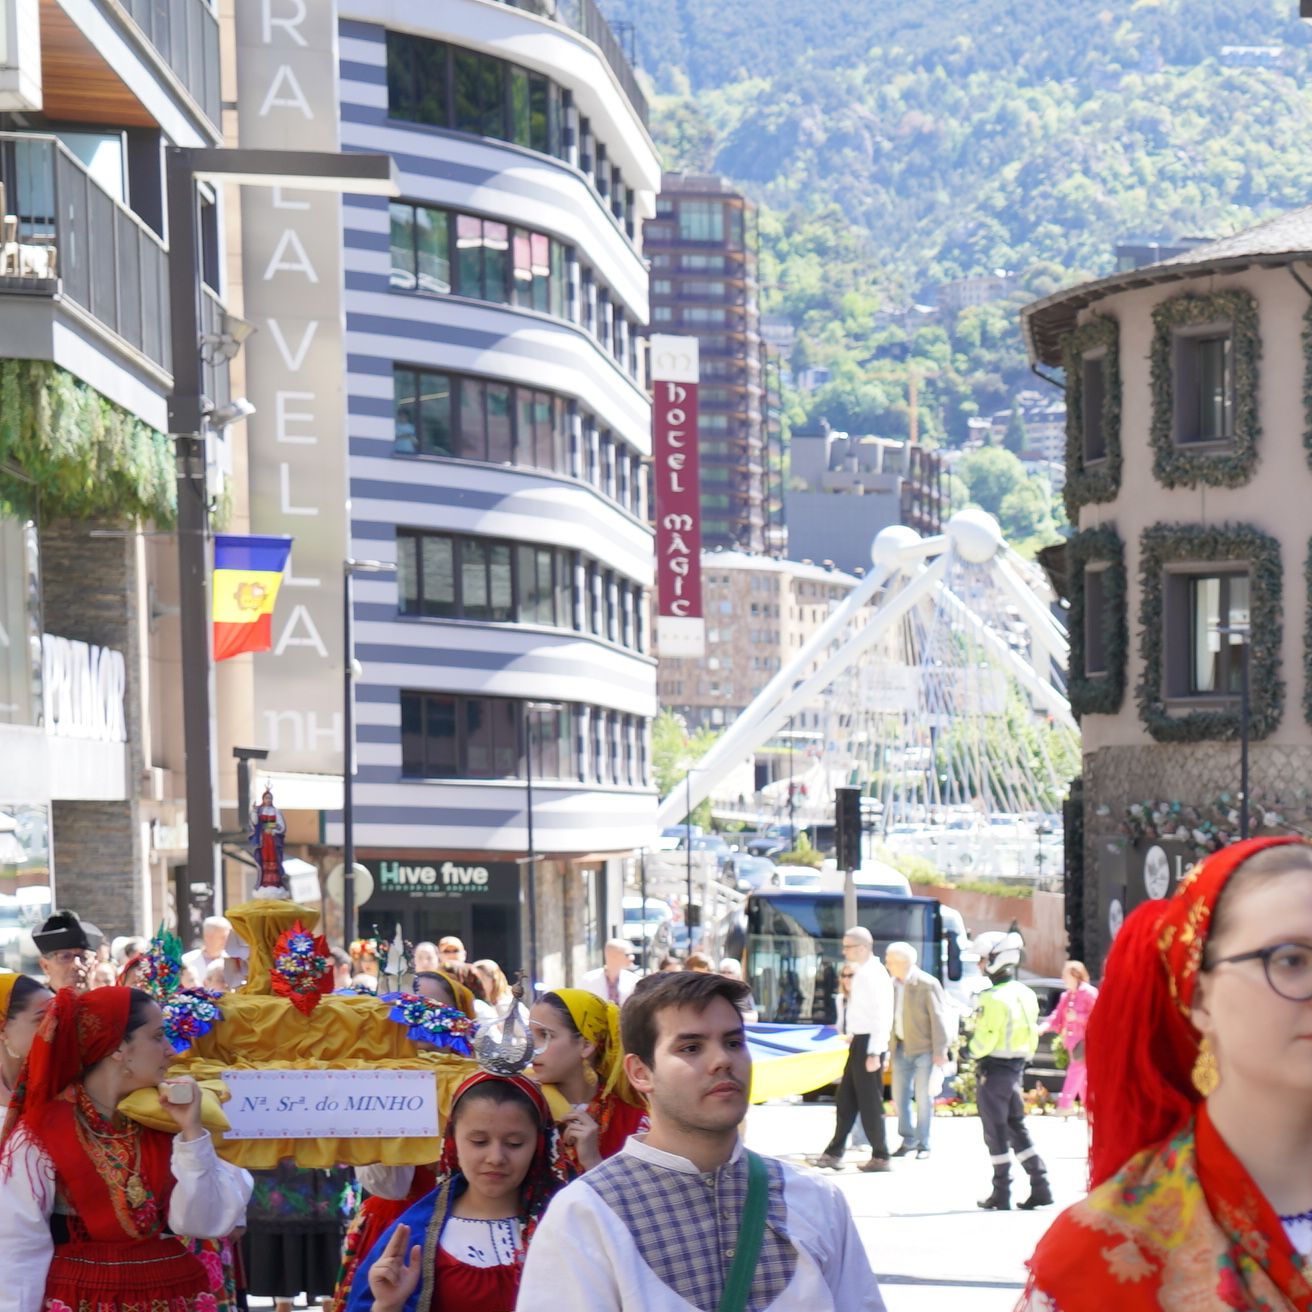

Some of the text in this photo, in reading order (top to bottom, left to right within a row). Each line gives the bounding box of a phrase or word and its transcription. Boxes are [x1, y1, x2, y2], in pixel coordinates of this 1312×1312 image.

[380, 861, 489, 885] Hive five
[315, 1095, 339, 1112] do
[344, 1095, 424, 1112] MINHO
